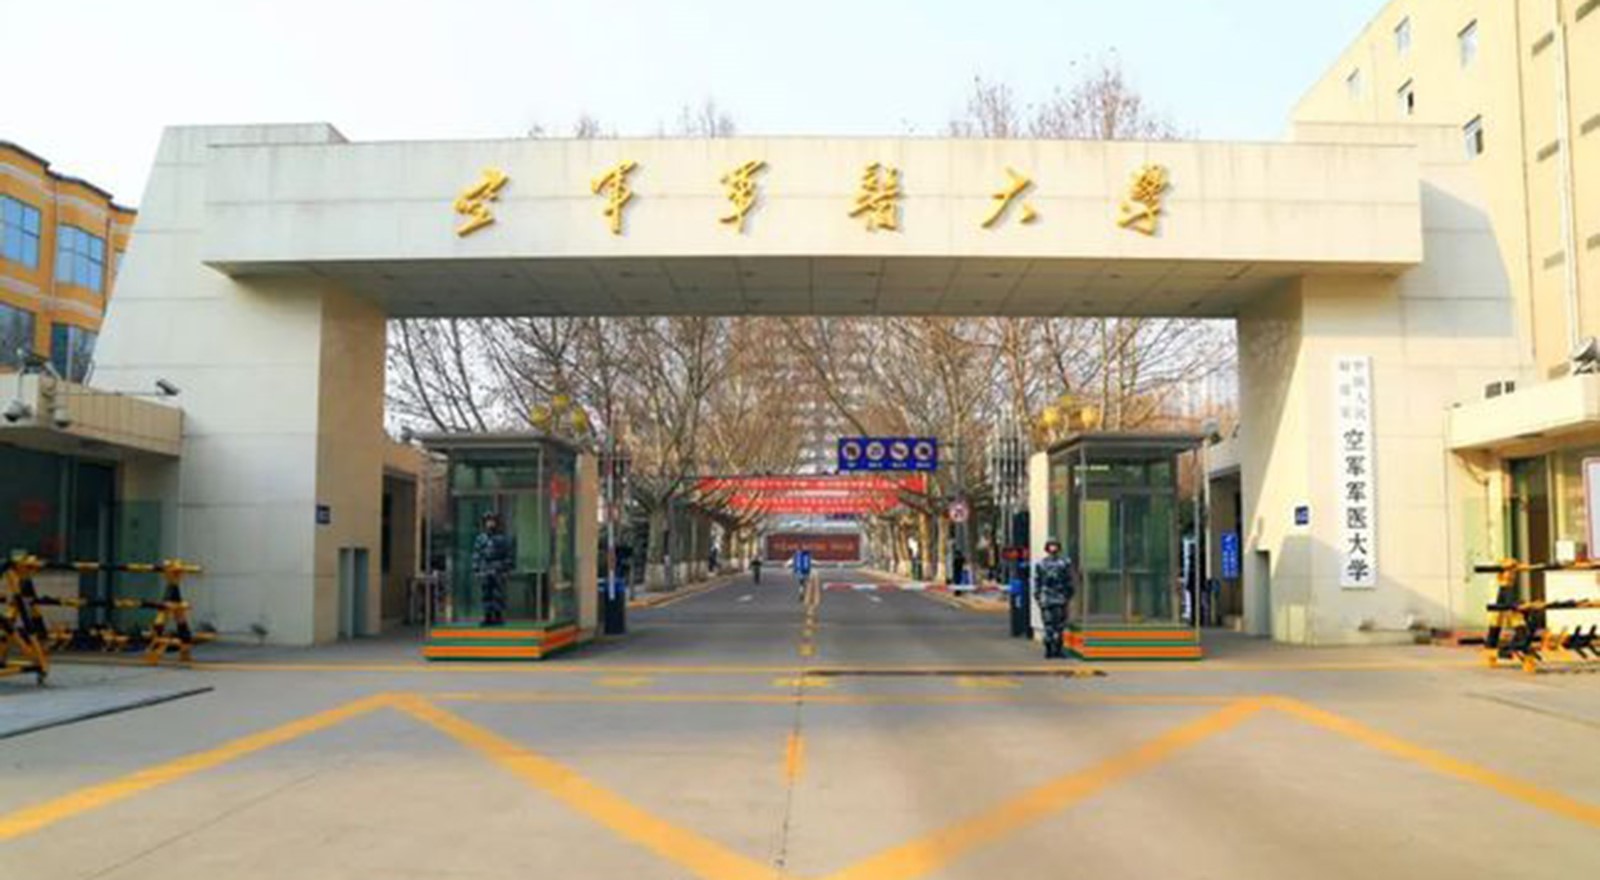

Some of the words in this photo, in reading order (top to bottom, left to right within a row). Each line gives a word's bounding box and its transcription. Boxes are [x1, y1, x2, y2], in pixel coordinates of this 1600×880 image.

[1344, 428, 1369, 581] 空军军医大学
